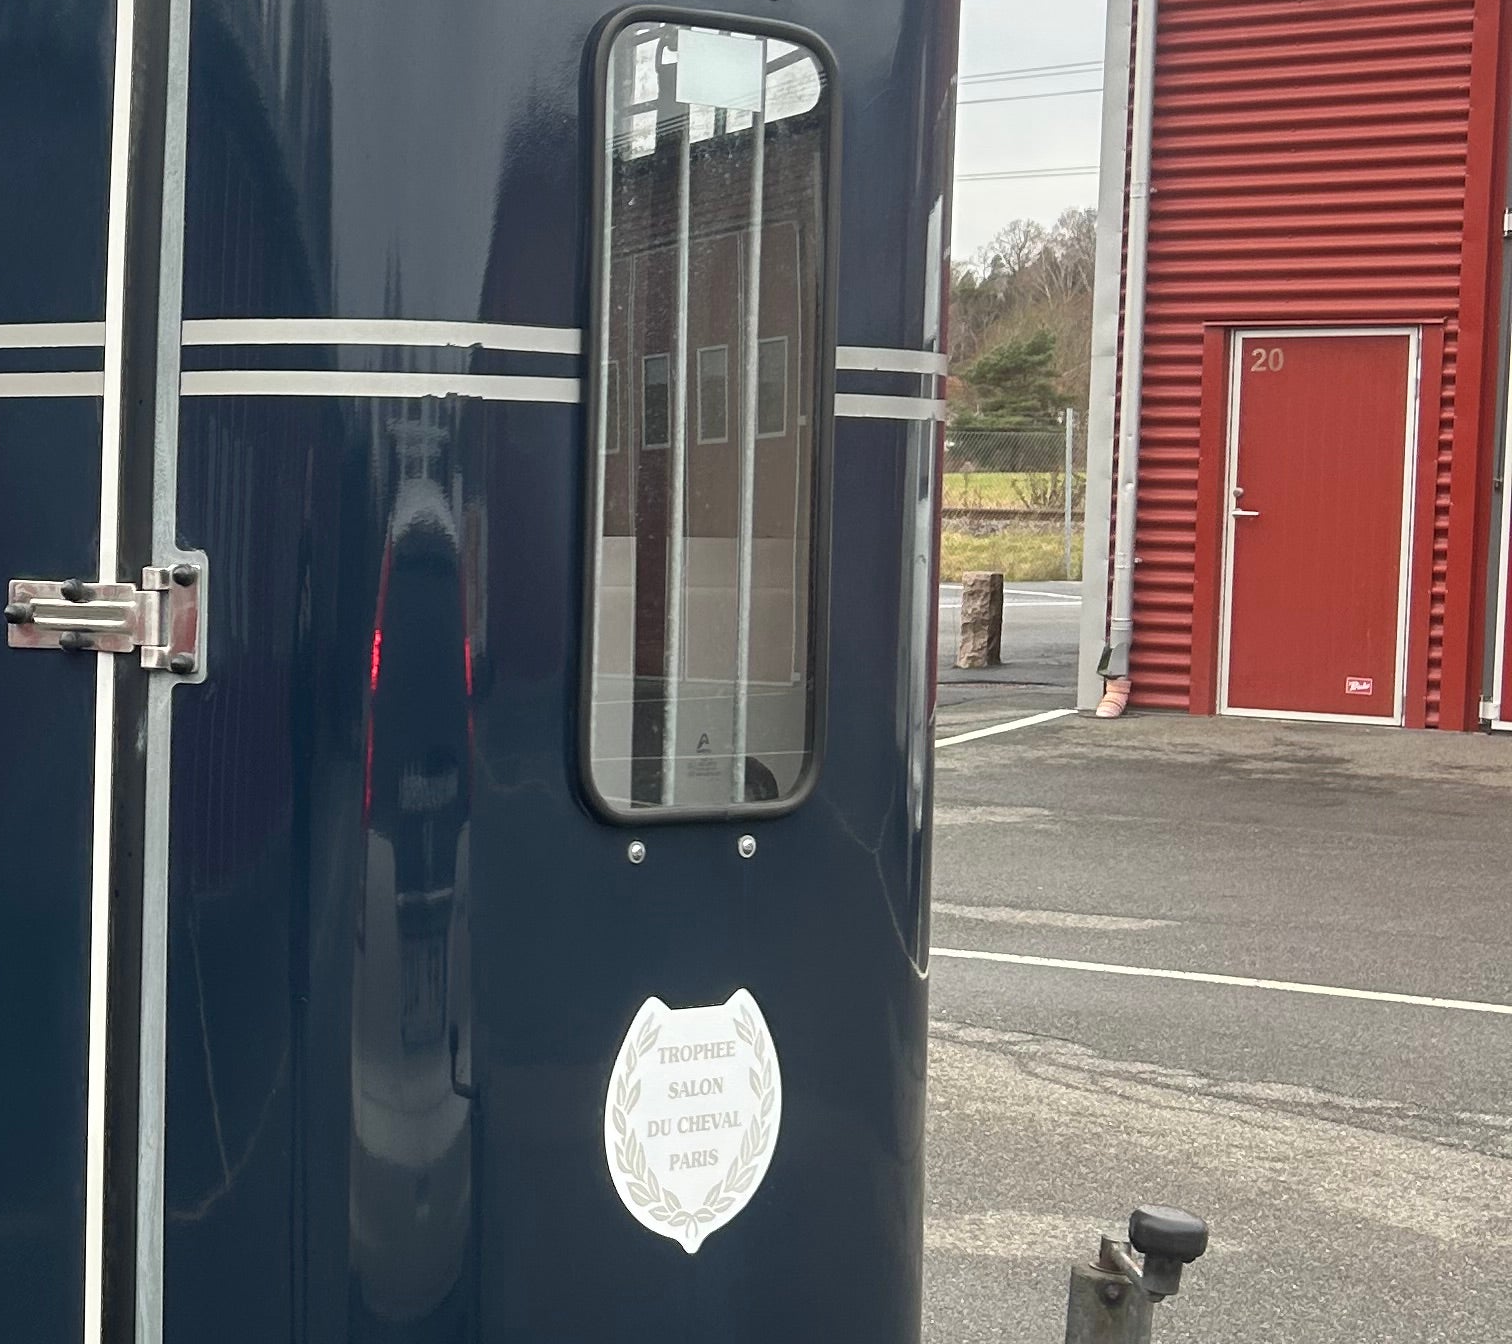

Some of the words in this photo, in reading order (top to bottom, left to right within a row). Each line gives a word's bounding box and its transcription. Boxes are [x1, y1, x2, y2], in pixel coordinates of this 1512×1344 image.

[1250, 348, 1284, 372] 20
[657, 1040, 736, 1064] TROPHEE
[668, 1077, 724, 1099] SALON
[647, 1119, 672, 1138] DU
[677, 1111, 742, 1134] CHEVAL
[669, 1148, 719, 1171] PARIS
